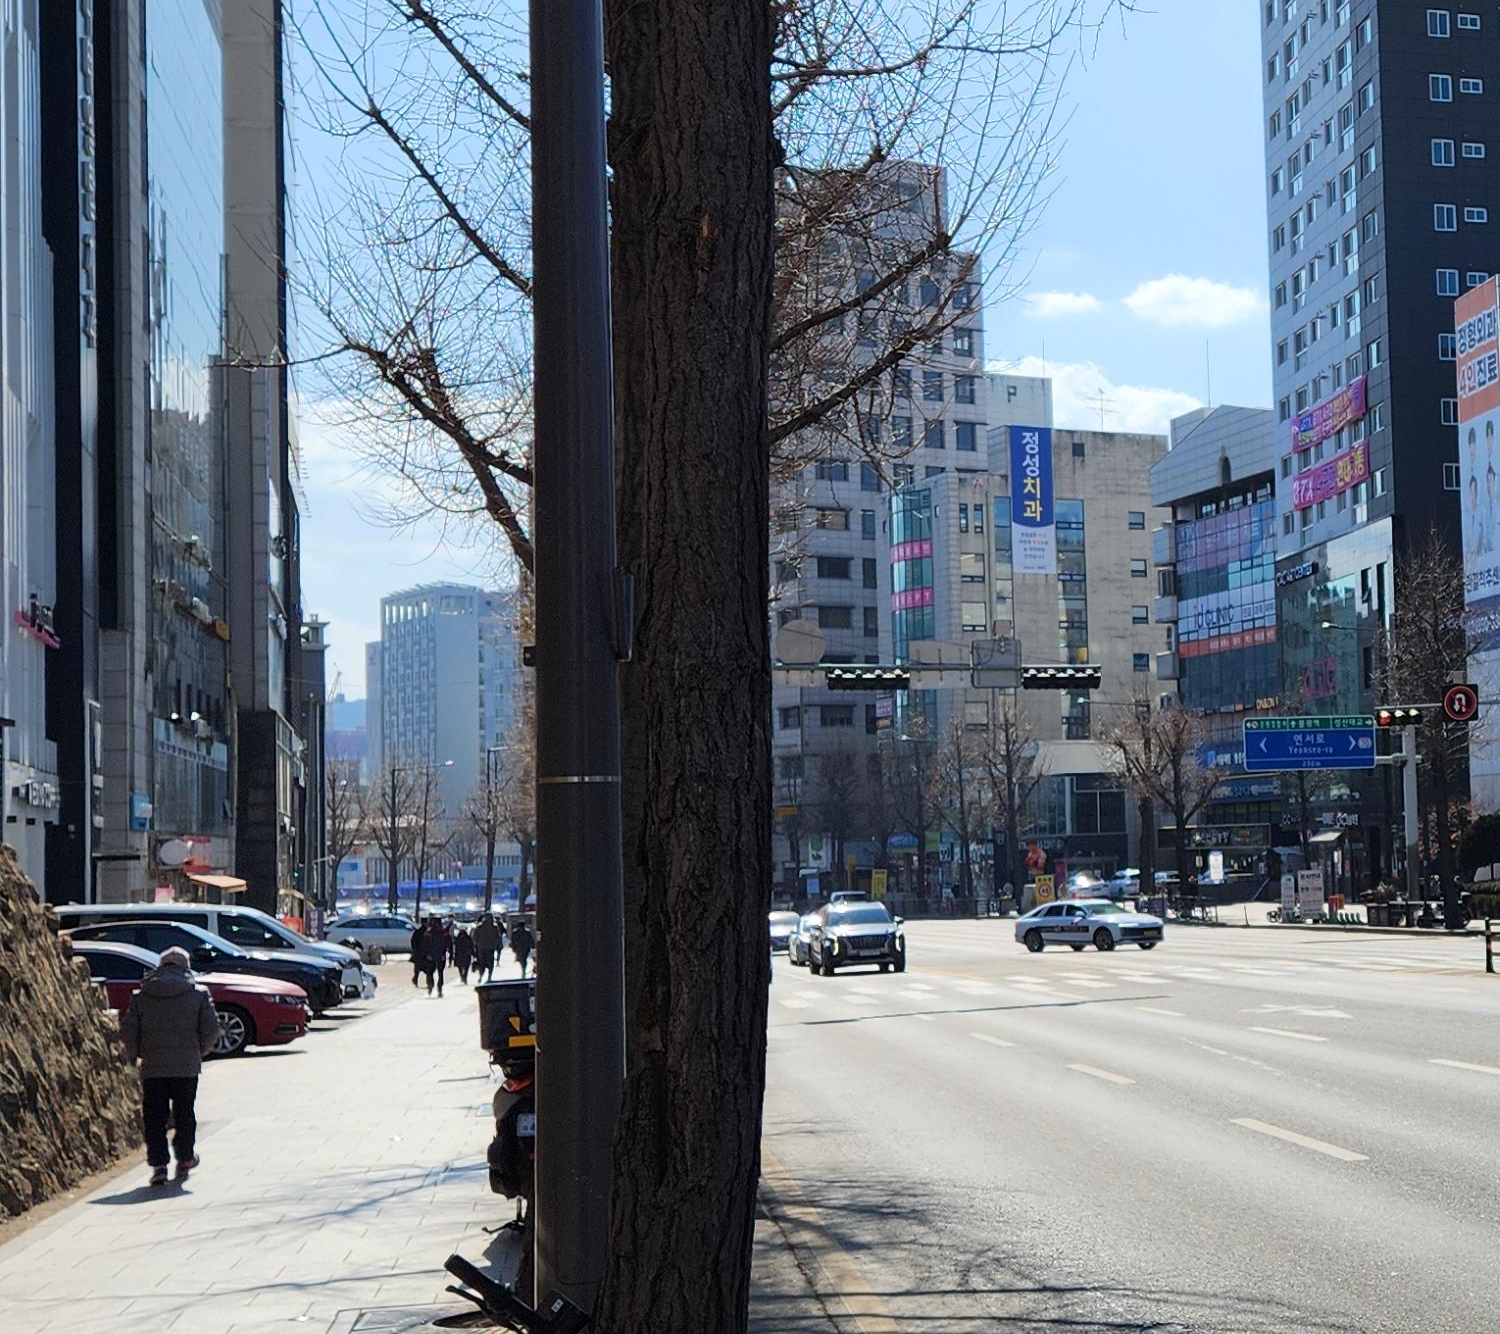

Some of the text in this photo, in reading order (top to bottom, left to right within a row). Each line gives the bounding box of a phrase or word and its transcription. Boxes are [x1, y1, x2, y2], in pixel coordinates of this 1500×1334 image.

[1458, 308, 1497, 354] 정형외과
[1022, 432, 1042, 522] 정성치과
[1293, 733, 1326, 746] 연서로
